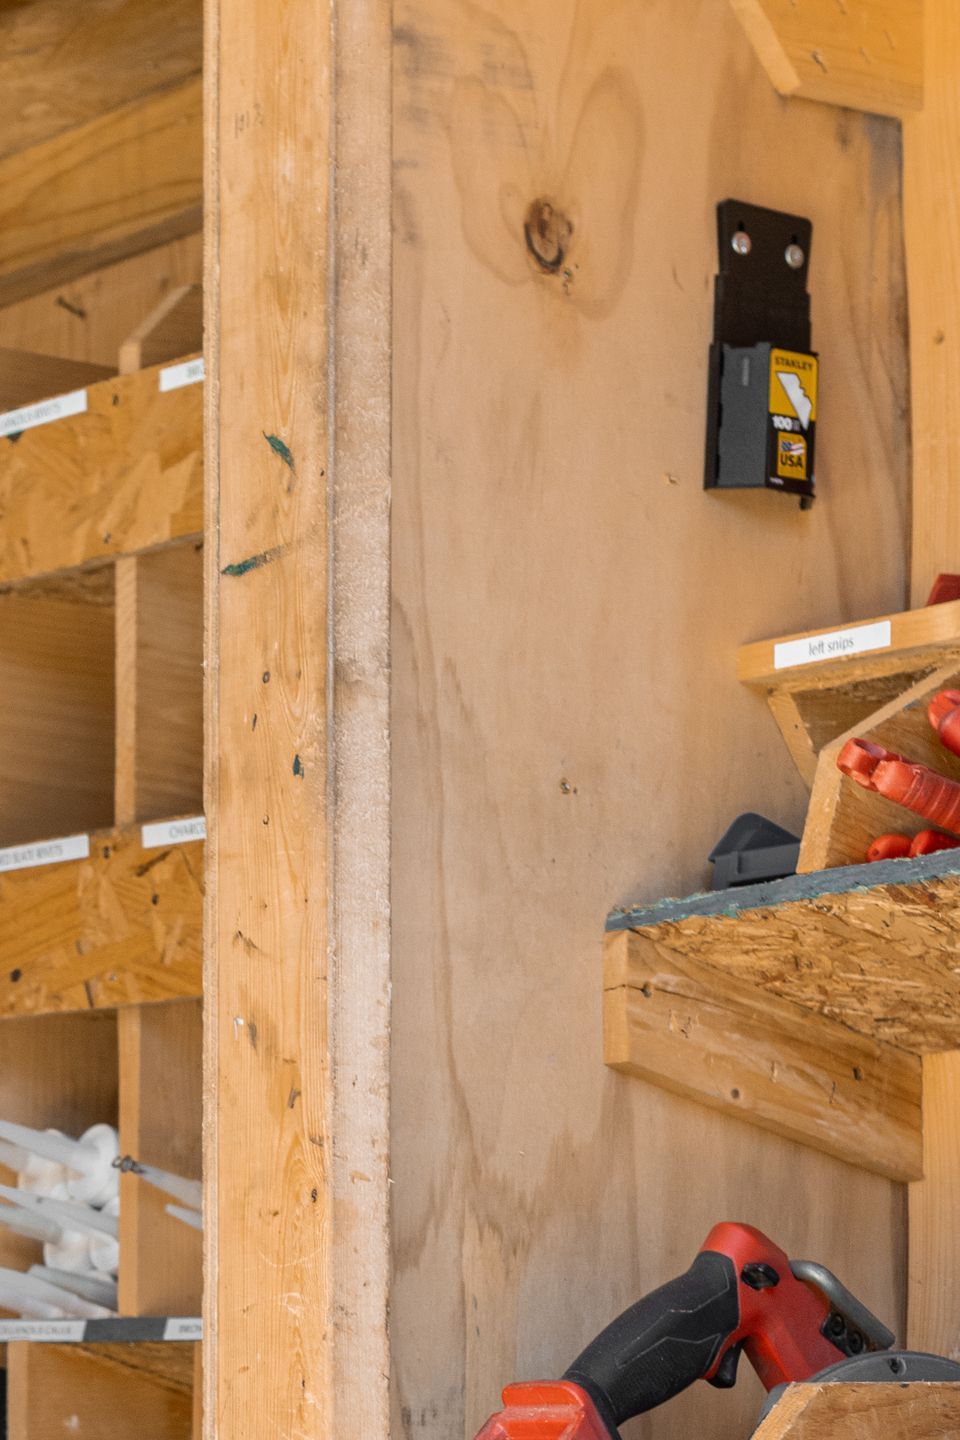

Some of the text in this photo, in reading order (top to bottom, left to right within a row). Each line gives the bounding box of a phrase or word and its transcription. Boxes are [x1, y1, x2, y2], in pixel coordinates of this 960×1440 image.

[775, 356, 813, 371] STANLEY
[772, 415, 792, 431] 100
[780, 454, 803, 468] USA
[808, 637, 855, 656] left snips
